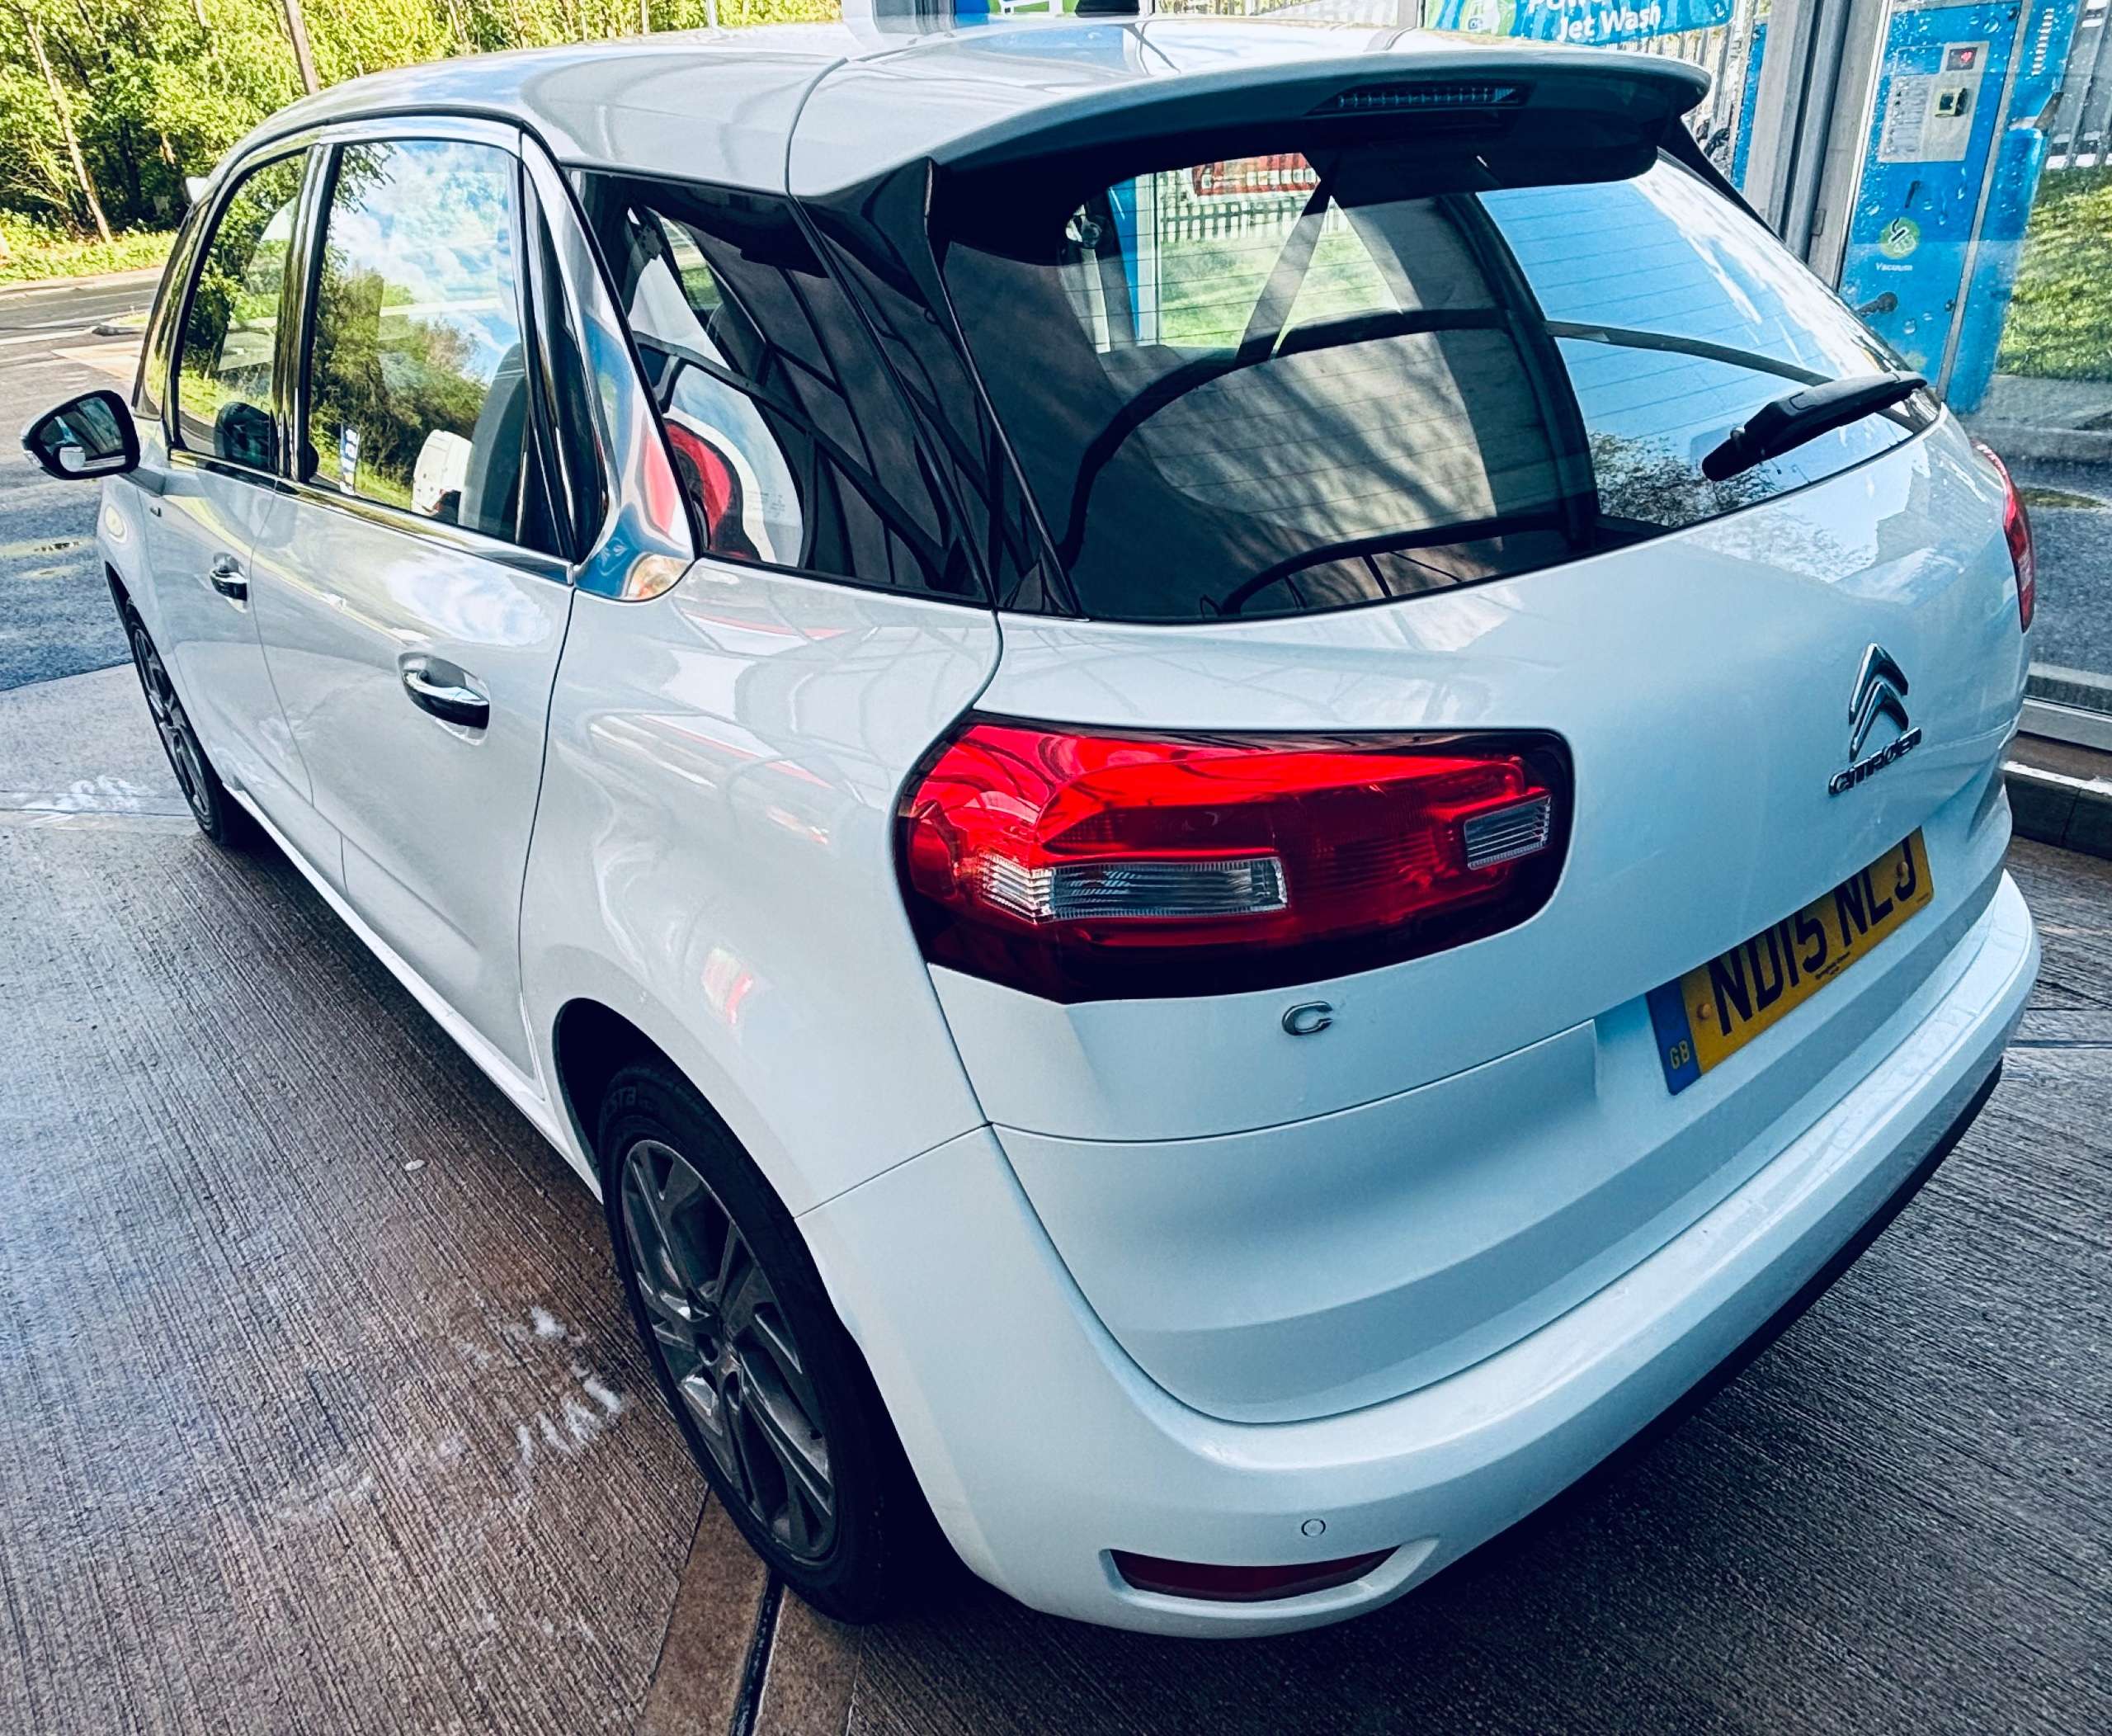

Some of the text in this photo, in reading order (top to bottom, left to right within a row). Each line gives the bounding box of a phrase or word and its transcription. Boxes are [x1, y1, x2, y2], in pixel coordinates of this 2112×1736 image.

[1556, 15, 1596, 42] Jet
[1600, 5, 1661, 34] Wash
[1875, 262, 1913, 271] Vacuum
[1707, 837, 1916, 1037] ND15 NLJ
[1670, 1040, 1690, 1069] GB
